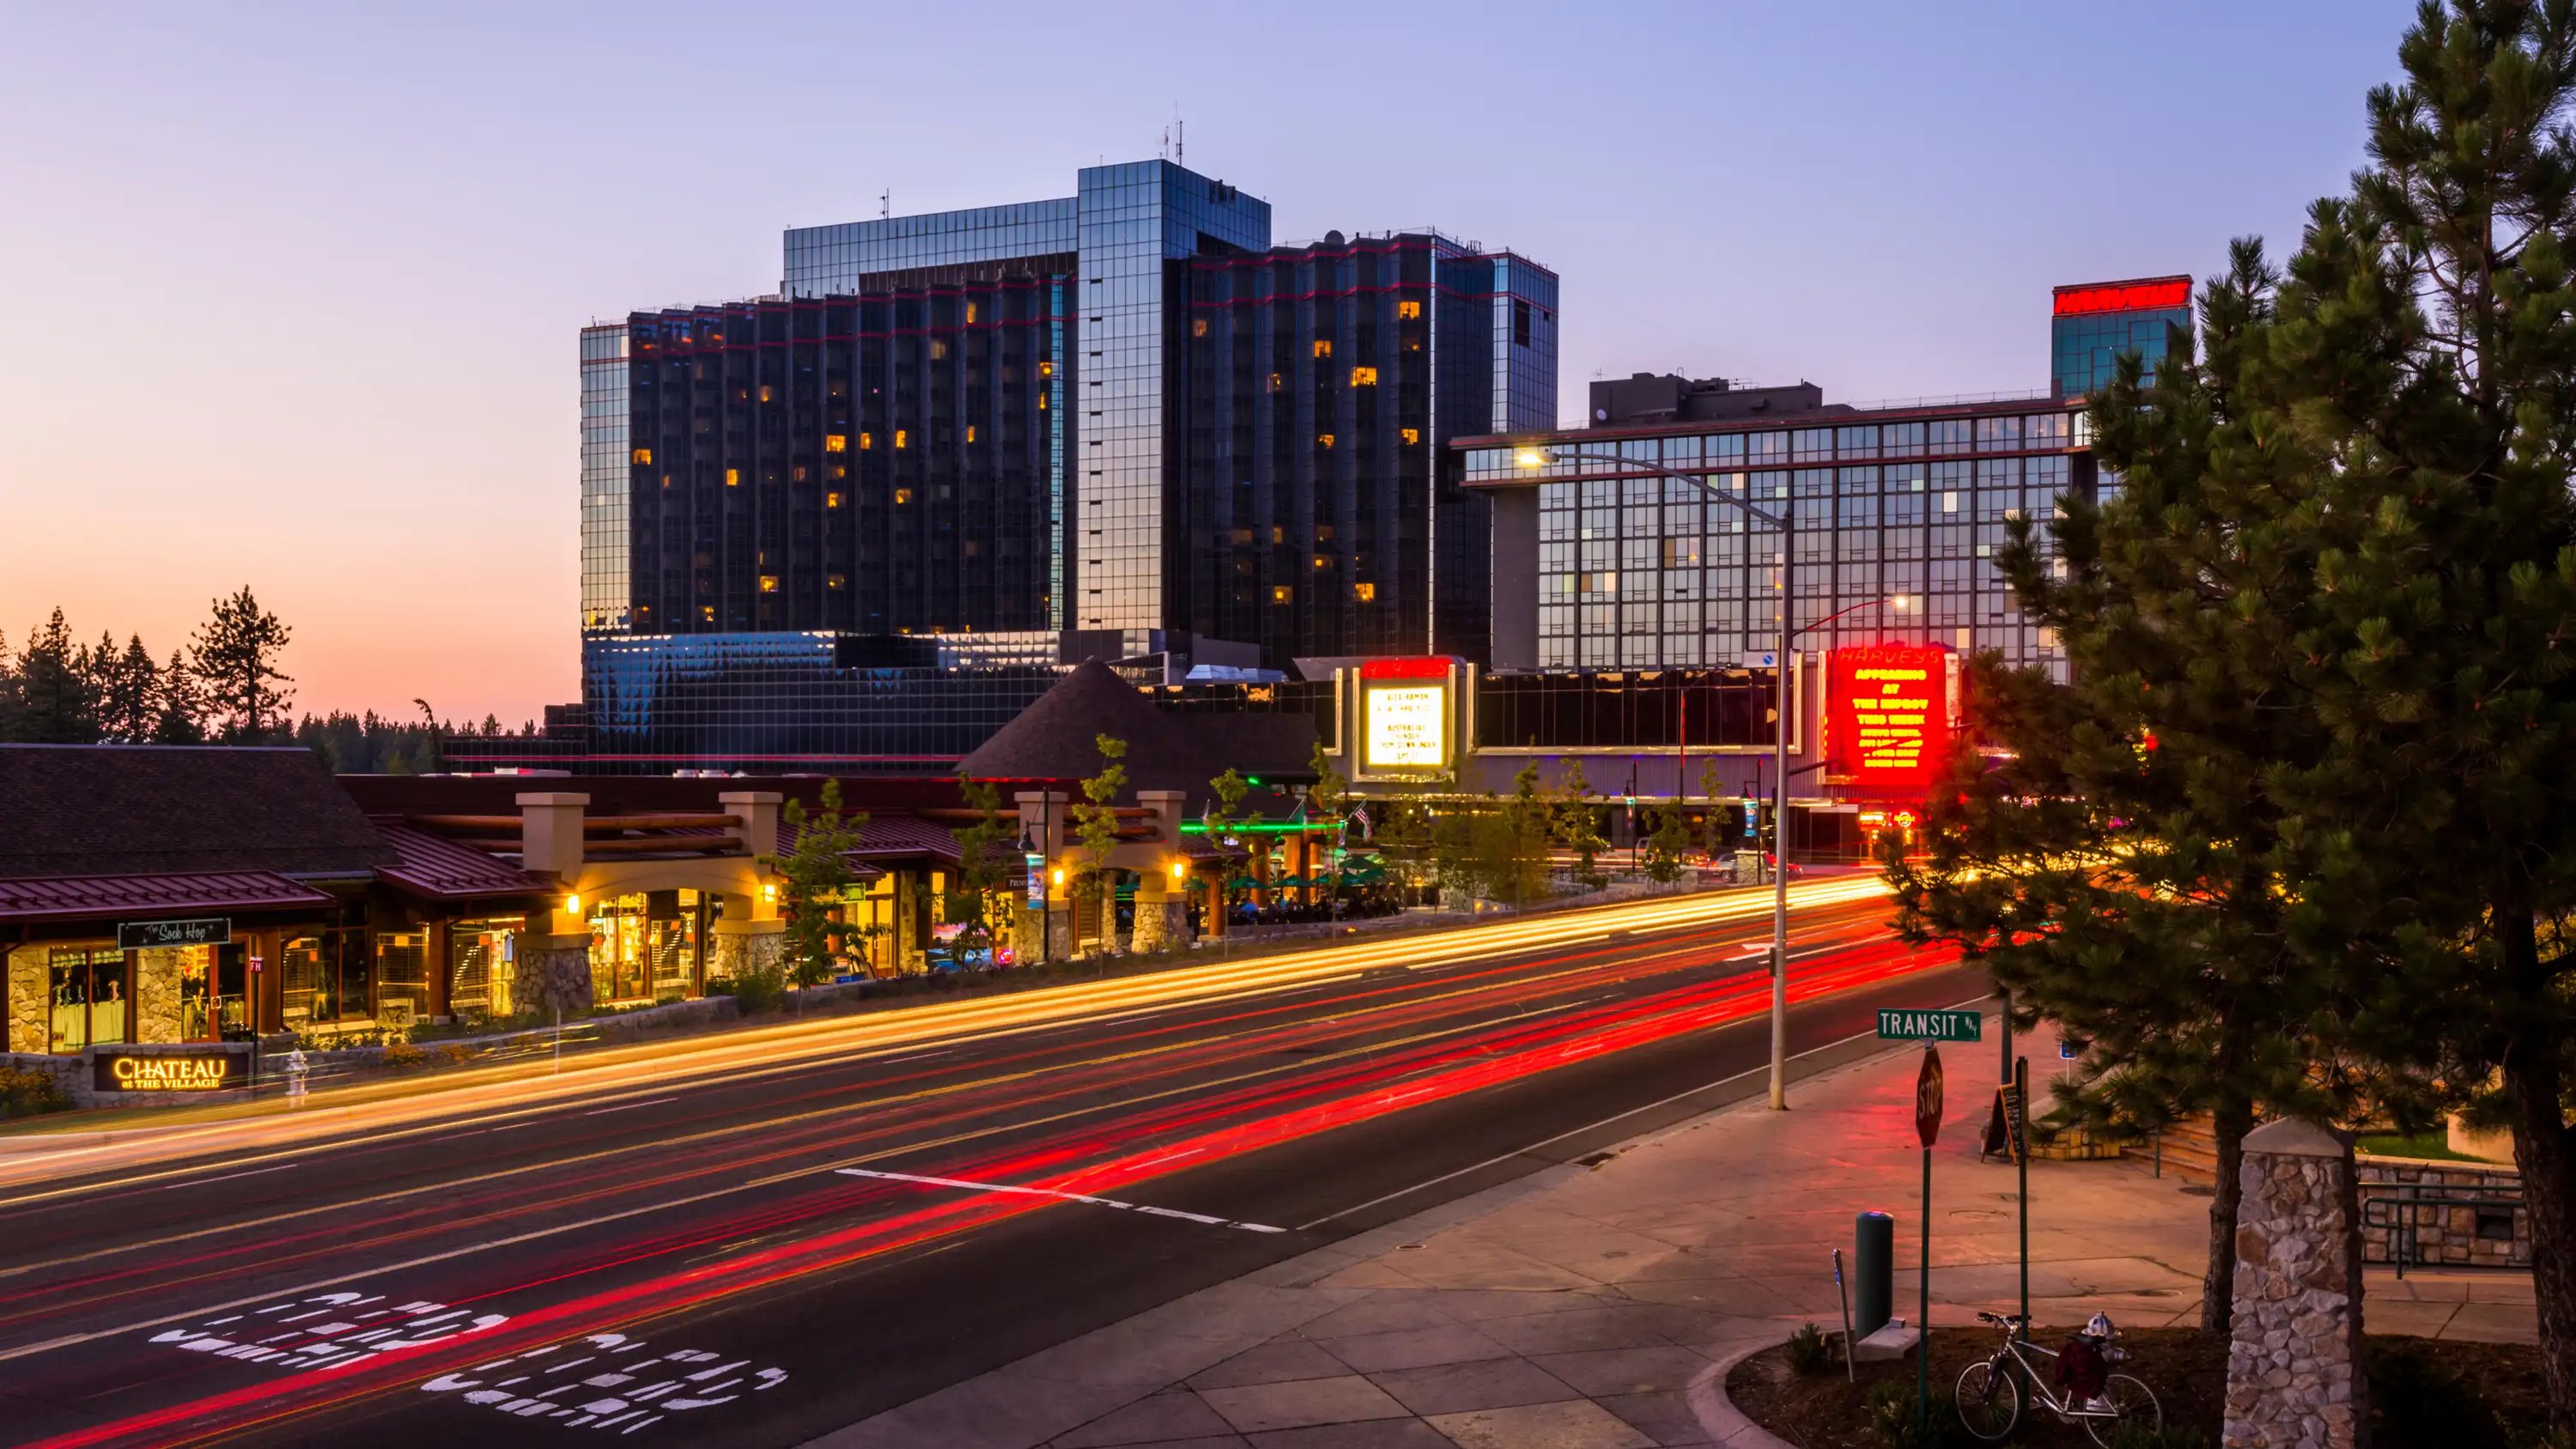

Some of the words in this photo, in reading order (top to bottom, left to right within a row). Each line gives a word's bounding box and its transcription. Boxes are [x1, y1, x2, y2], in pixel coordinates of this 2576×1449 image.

[1839, 649, 1939, 664] HARVEYS
[144, 924, 158, 935] The
[185, 922, 206, 942] Hop
[1880, 1013, 1958, 1037] TRANSIT
[1965, 1016, 1978, 1037] WAY
[115, 1057, 227, 1079] CHATEAU
[121, 1080, 133, 1089] at
[135, 1079, 161, 1089] THE
[163, 1079, 220, 1089] VILLAGE
[1917, 1079, 1941, 1120] STOP
